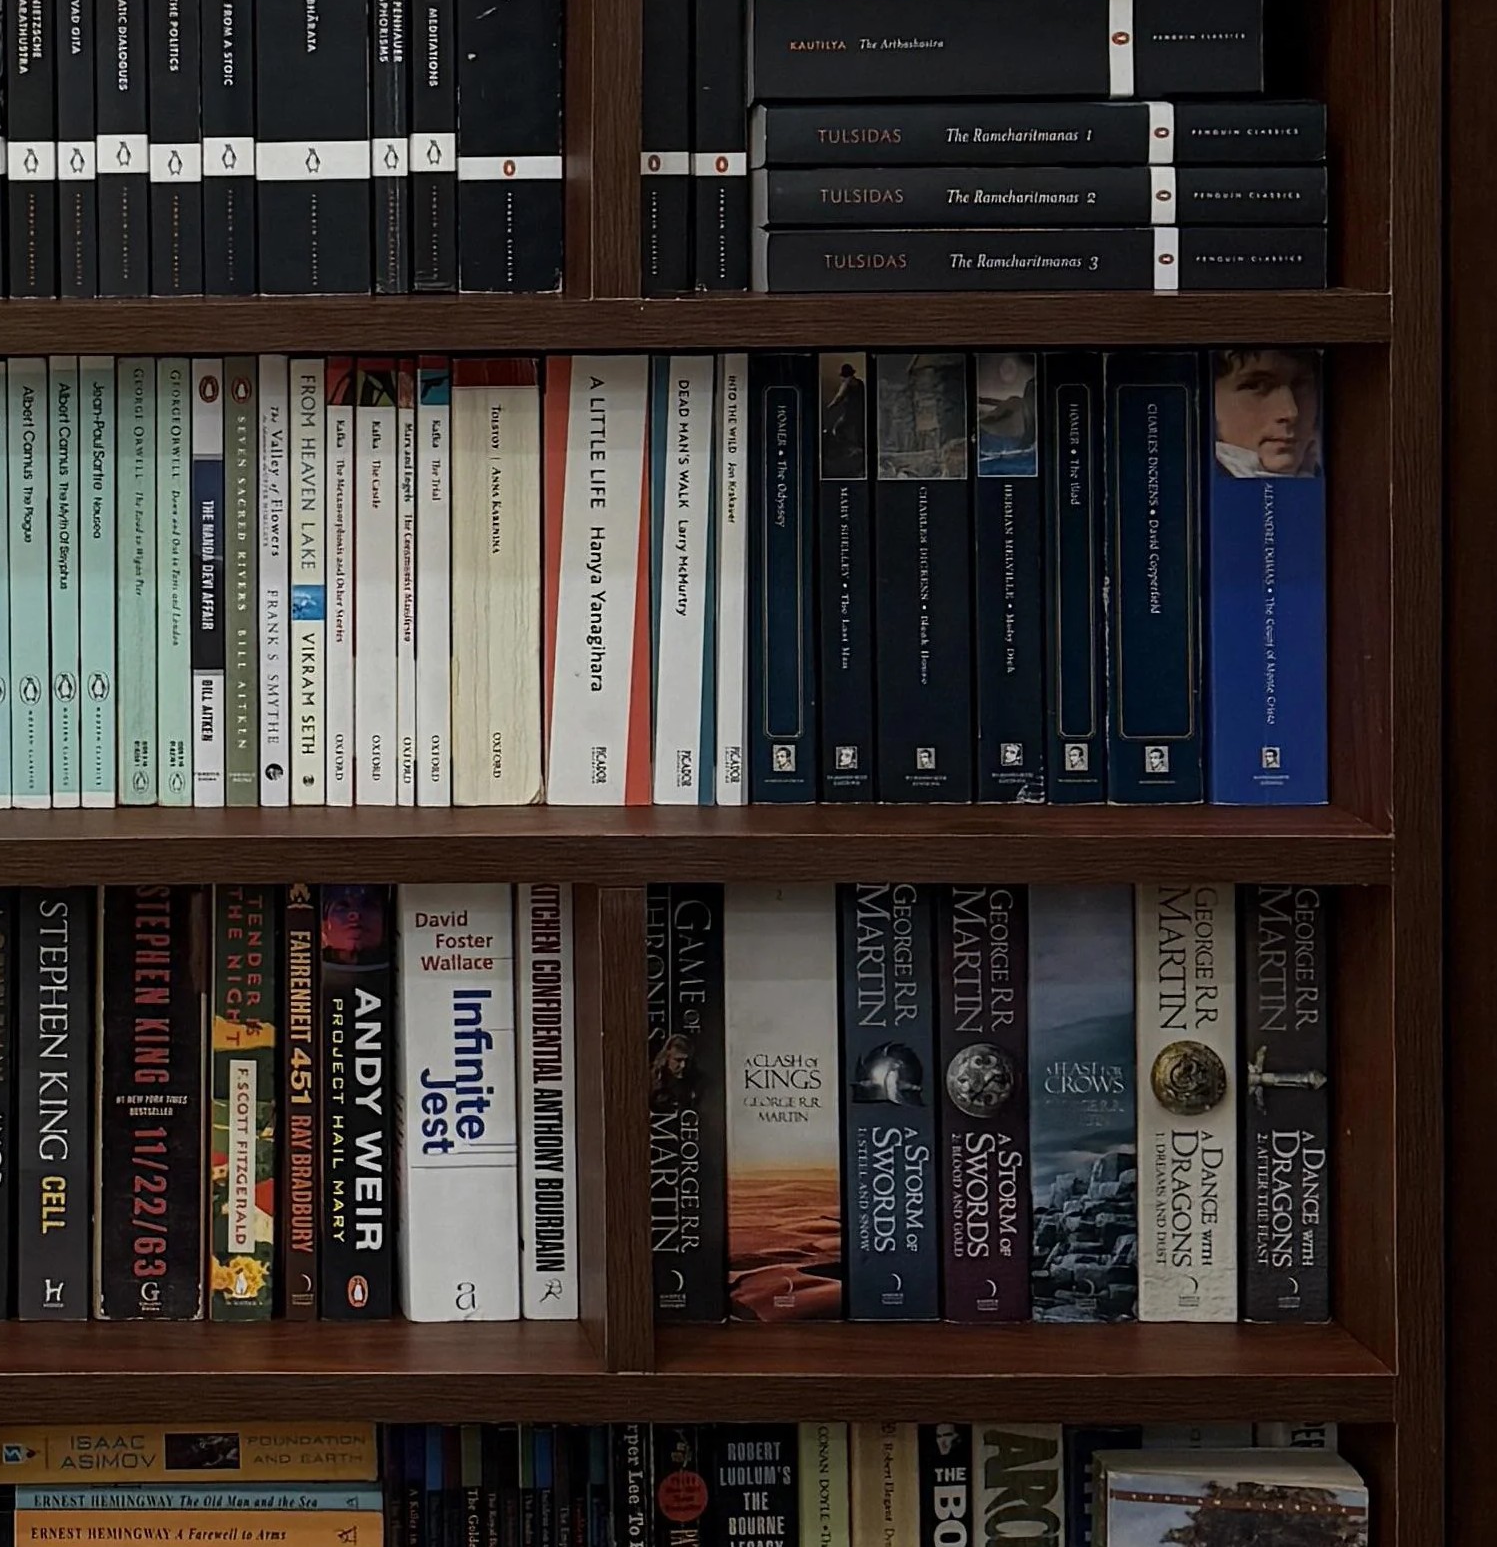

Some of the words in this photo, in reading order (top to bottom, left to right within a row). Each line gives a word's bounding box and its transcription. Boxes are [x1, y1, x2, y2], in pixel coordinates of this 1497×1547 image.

[818, 128, 902, 143] TULSIDAS
[946, 127, 969, 143] The
[973, 127, 1079, 144] Ramcharitmanas
[1087, 128, 1091, 142] 1
[591, 377, 604, 390] A
[591, 397, 604, 462] LITTLE
[591, 468, 605, 509] LIFE
[586, 527, 605, 585] Hanya
[587, 590, 606, 692] Yanagihara
[415, 912, 467, 927] David
[435, 933, 492, 948] Foster
[421, 954, 492, 970] Wallace
[353, 989, 382, 1115] ANDY
[452, 990, 492, 1141] Infinite
[744, 1070, 821, 1089] KINGS
[421, 1070, 455, 1156] Jest
[354, 1131, 383, 1251] WEIR
[133, 1128, 167, 1279] 11/22/63
[727, 1443, 781, 1461] ROBERT
[720, 1465, 791, 1485] LUDLUM'S
[743, 1492, 768, 1510] THE
[31, 1527, 85, 1541] ERNEST
[89, 1527, 170, 1541] HEMINGWAY
[175, 1528, 182, 1540] A
[189, 1527, 236, 1541] Farewell
[257, 1527, 286, 1541] Arms
[729, 1516, 785, 1534] BOURNE
